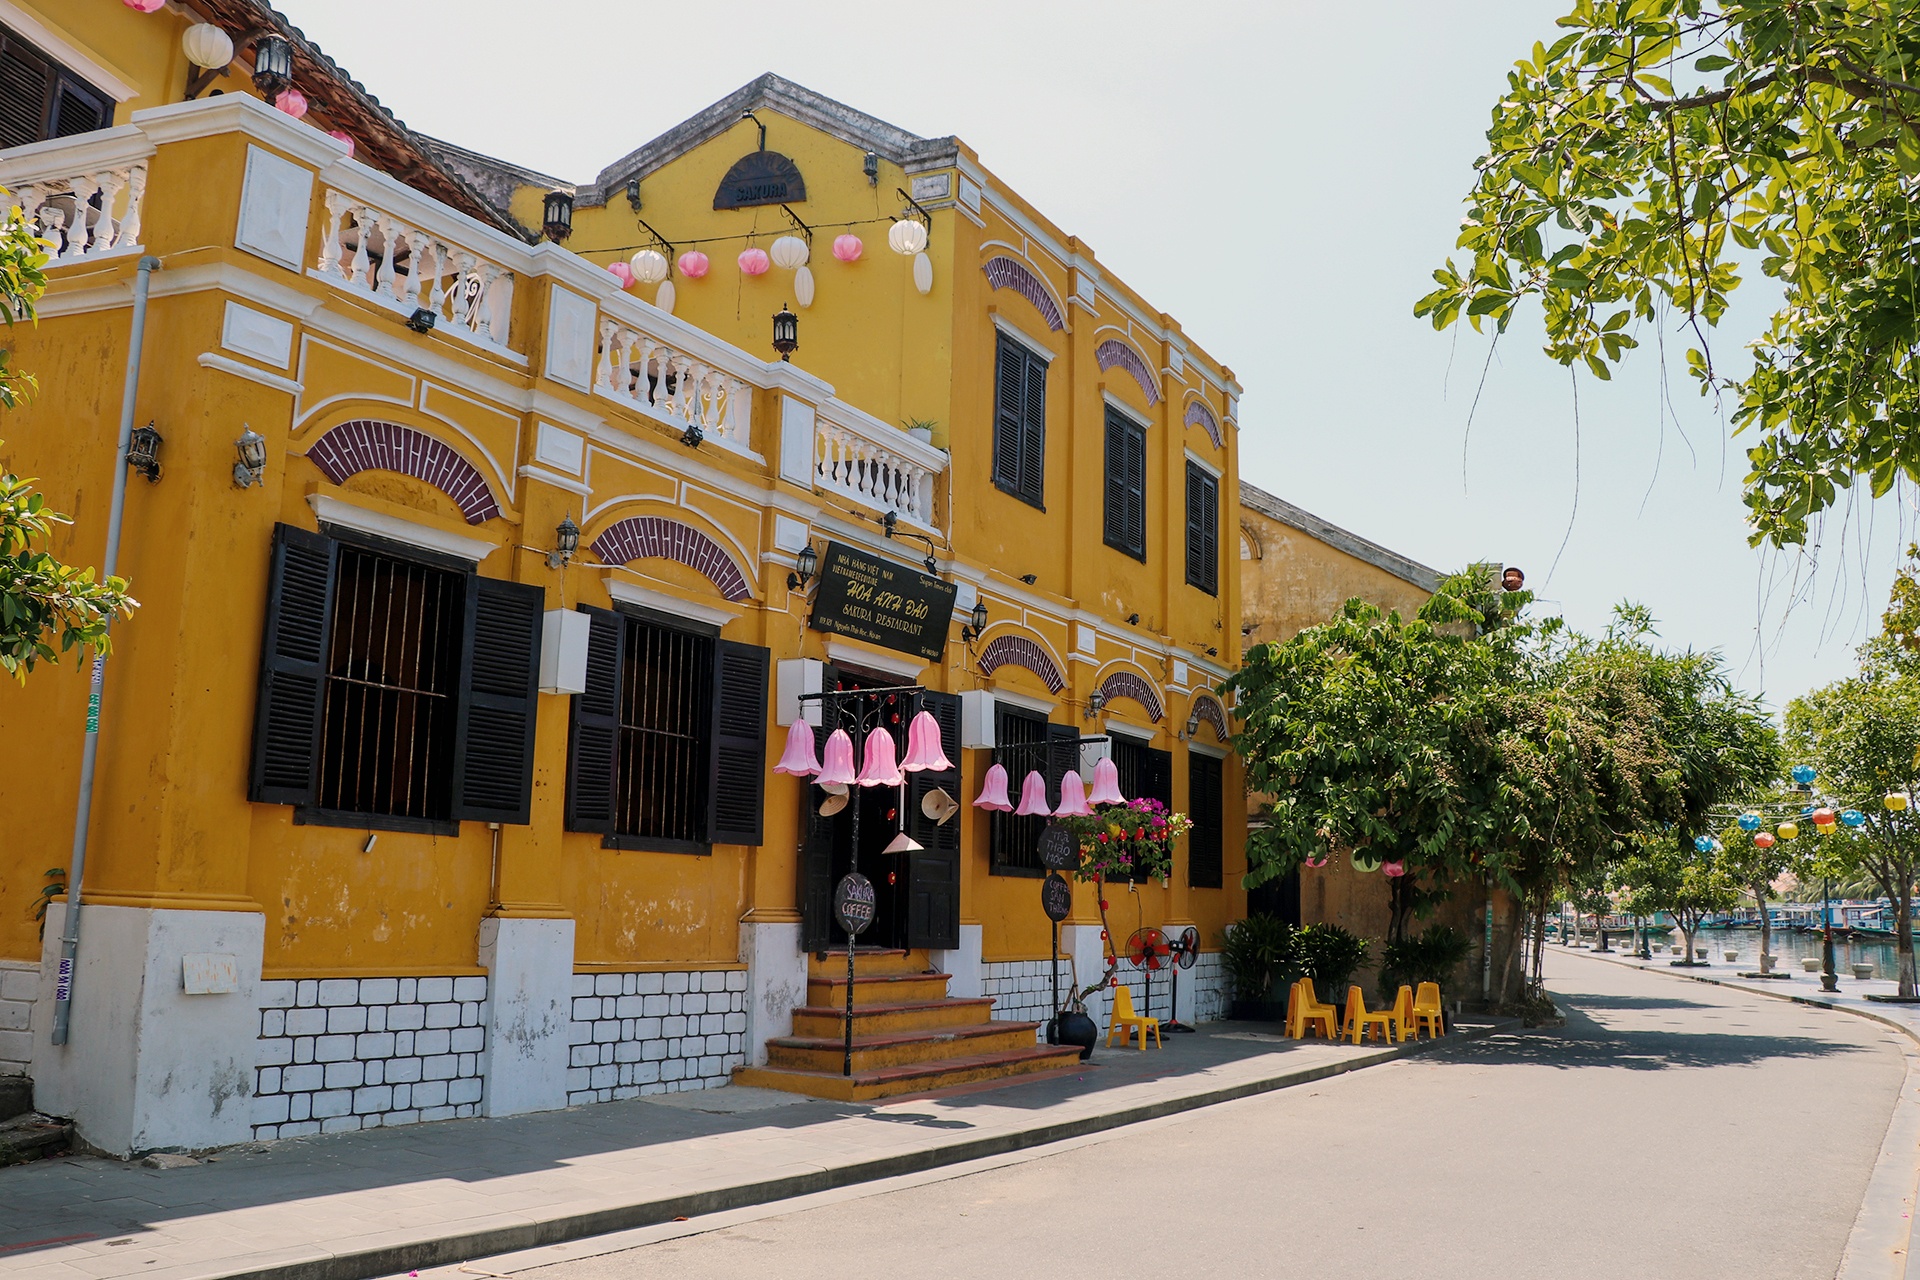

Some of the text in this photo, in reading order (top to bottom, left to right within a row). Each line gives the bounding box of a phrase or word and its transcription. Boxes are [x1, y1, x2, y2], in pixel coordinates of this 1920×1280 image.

[736, 183, 787, 201] SAKURA
[838, 554, 894, 581] NHÀ HÀNG VIỆT NAM
[847, 580, 929, 619] HOA ANH ĐÀO
[842, 603, 923, 636] SAKURA RESTAURANT
[847, 883, 875, 903] SAKURA
[842, 902, 872, 919] COFFEE
